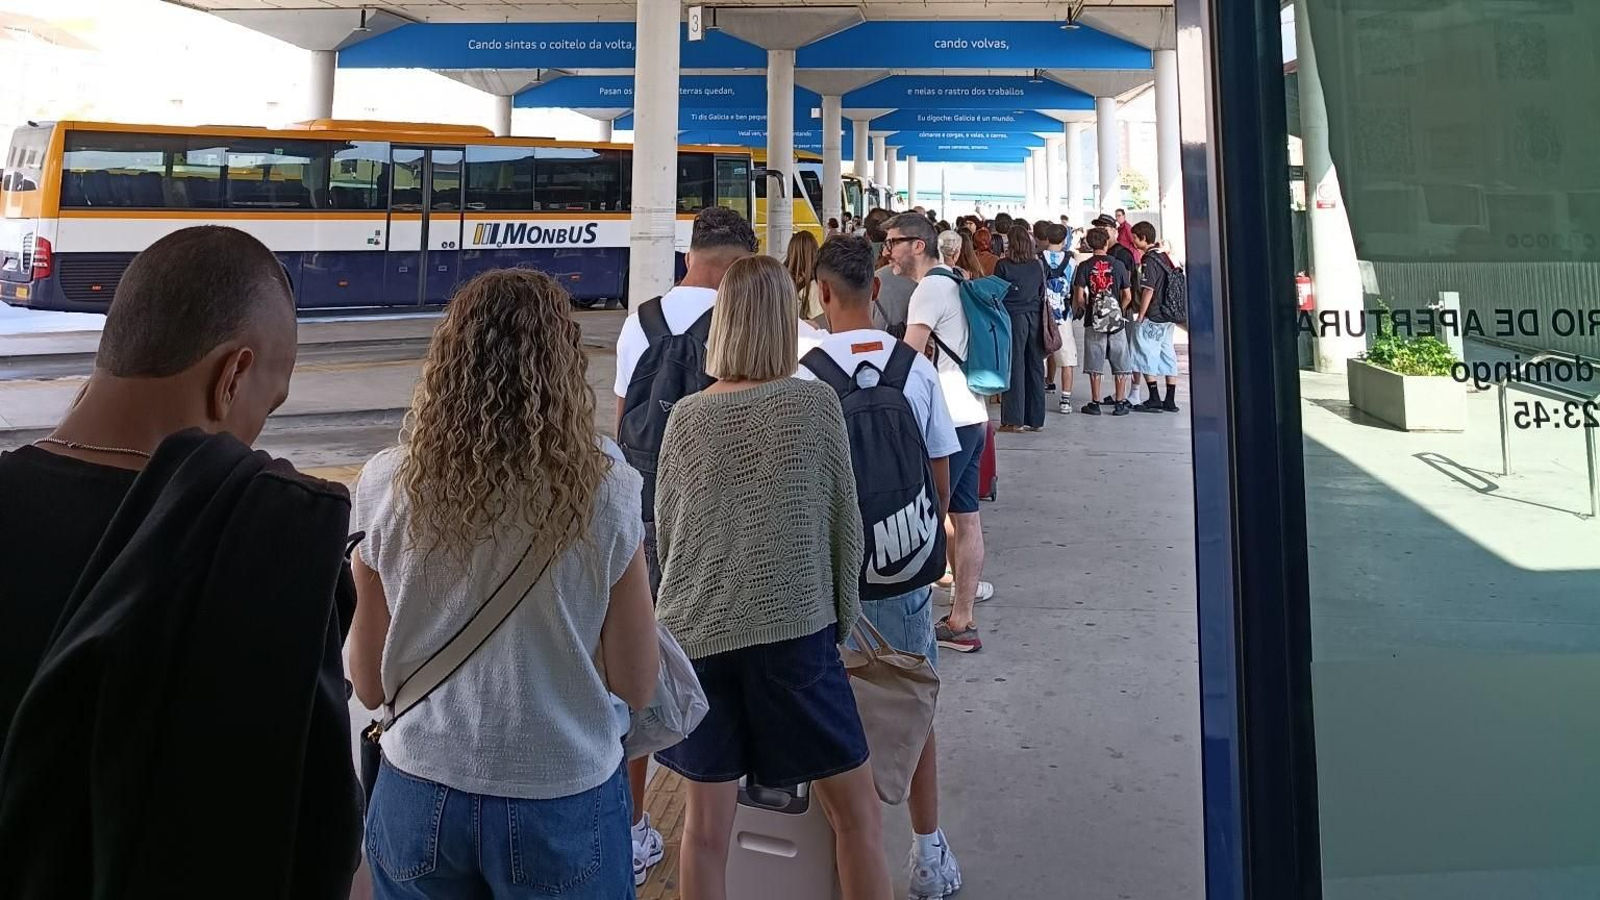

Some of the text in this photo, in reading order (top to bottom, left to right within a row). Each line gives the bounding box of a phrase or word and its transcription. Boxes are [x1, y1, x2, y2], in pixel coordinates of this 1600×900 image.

[692, 14, 699, 33] 3
[468, 39, 635, 51] Cando sintas o coitelo da volta,
[934, 38, 1010, 51] cando volvas,
[599, 87, 622, 96] Pasan
[704, 87, 735, 97] quedan,
[945, 88, 969, 96] rastro
[972, 87, 986, 96] dos
[988, 87, 1024, 96] traballos
[748, 114, 767, 122] peque
[918, 114, 926, 122] Eu
[954, 114, 975, 122] Galicia
[874, 483, 936, 570] NIKE
